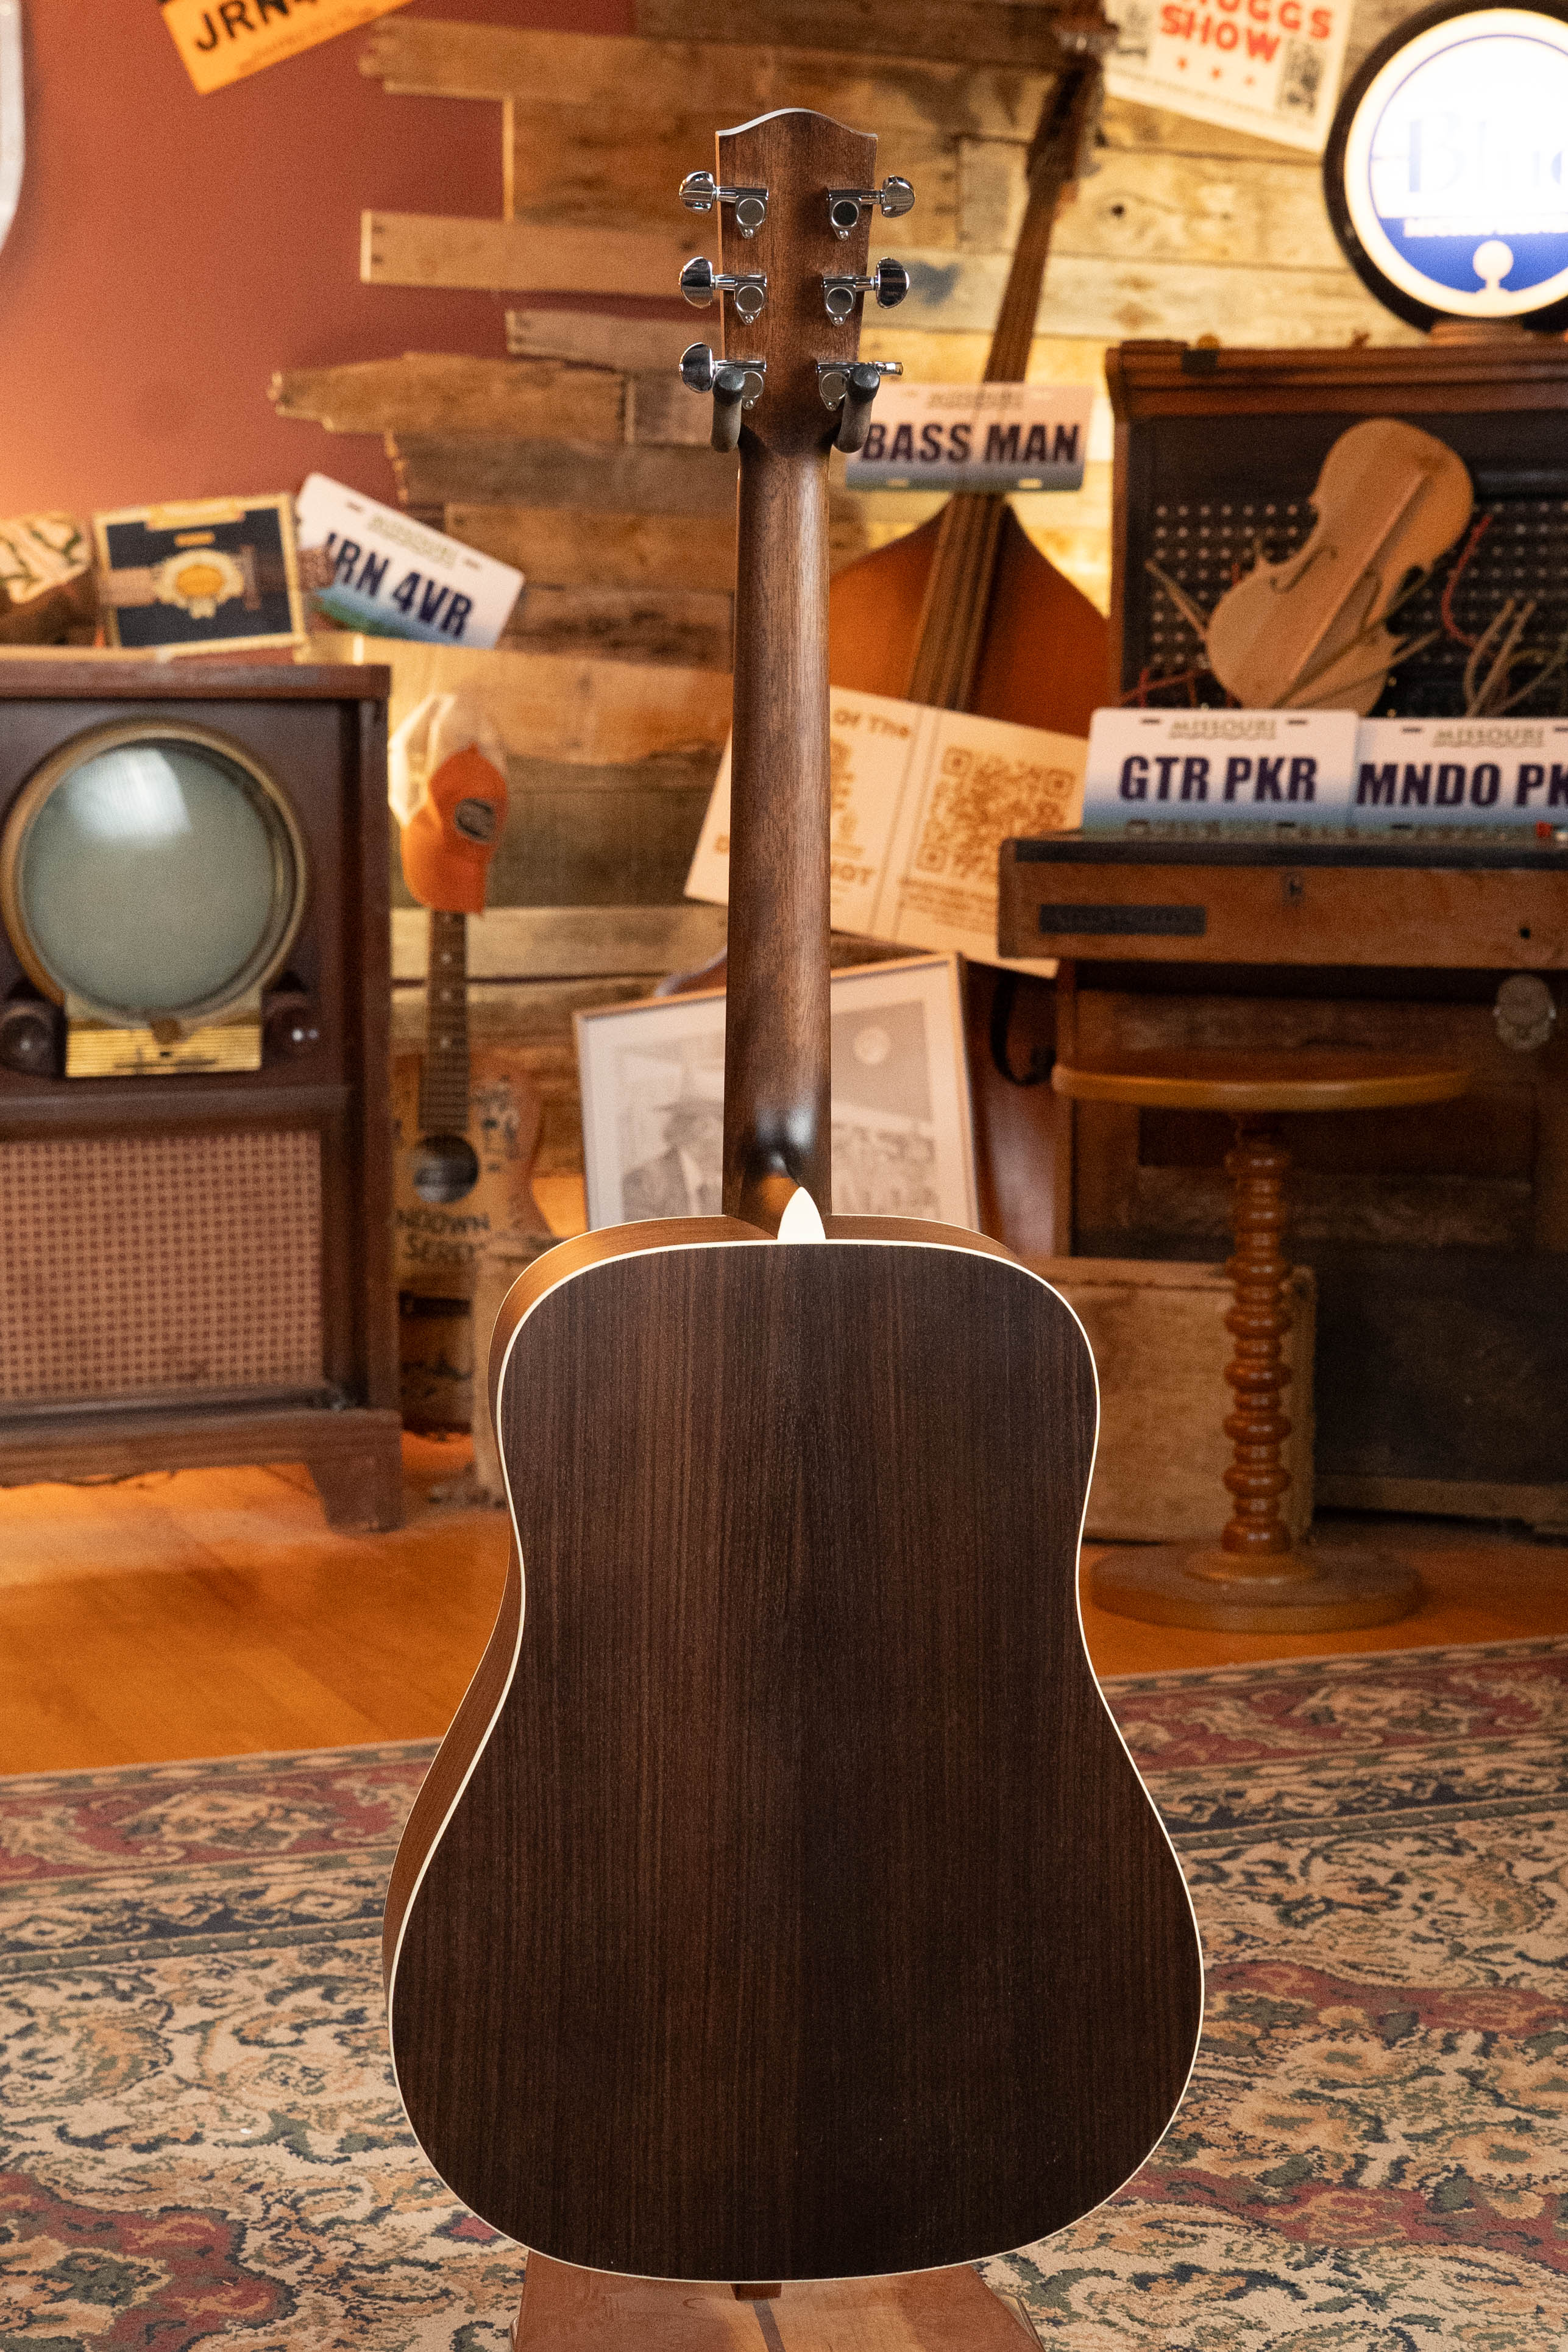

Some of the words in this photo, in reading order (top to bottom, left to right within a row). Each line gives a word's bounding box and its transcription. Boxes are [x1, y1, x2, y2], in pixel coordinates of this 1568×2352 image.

[1160, 5, 1280, 62] SHOW
[860, 423, 973, 463] BASS
[984, 423, 1079, 463] MAN
[327, 532, 390, 598] RN
[392, 570, 473, 638] 4VR
[1119, 755, 1209, 801] GTR
[1224, 756, 1318, 802] PKR
[1357, 763, 1502, 808] MNDO
